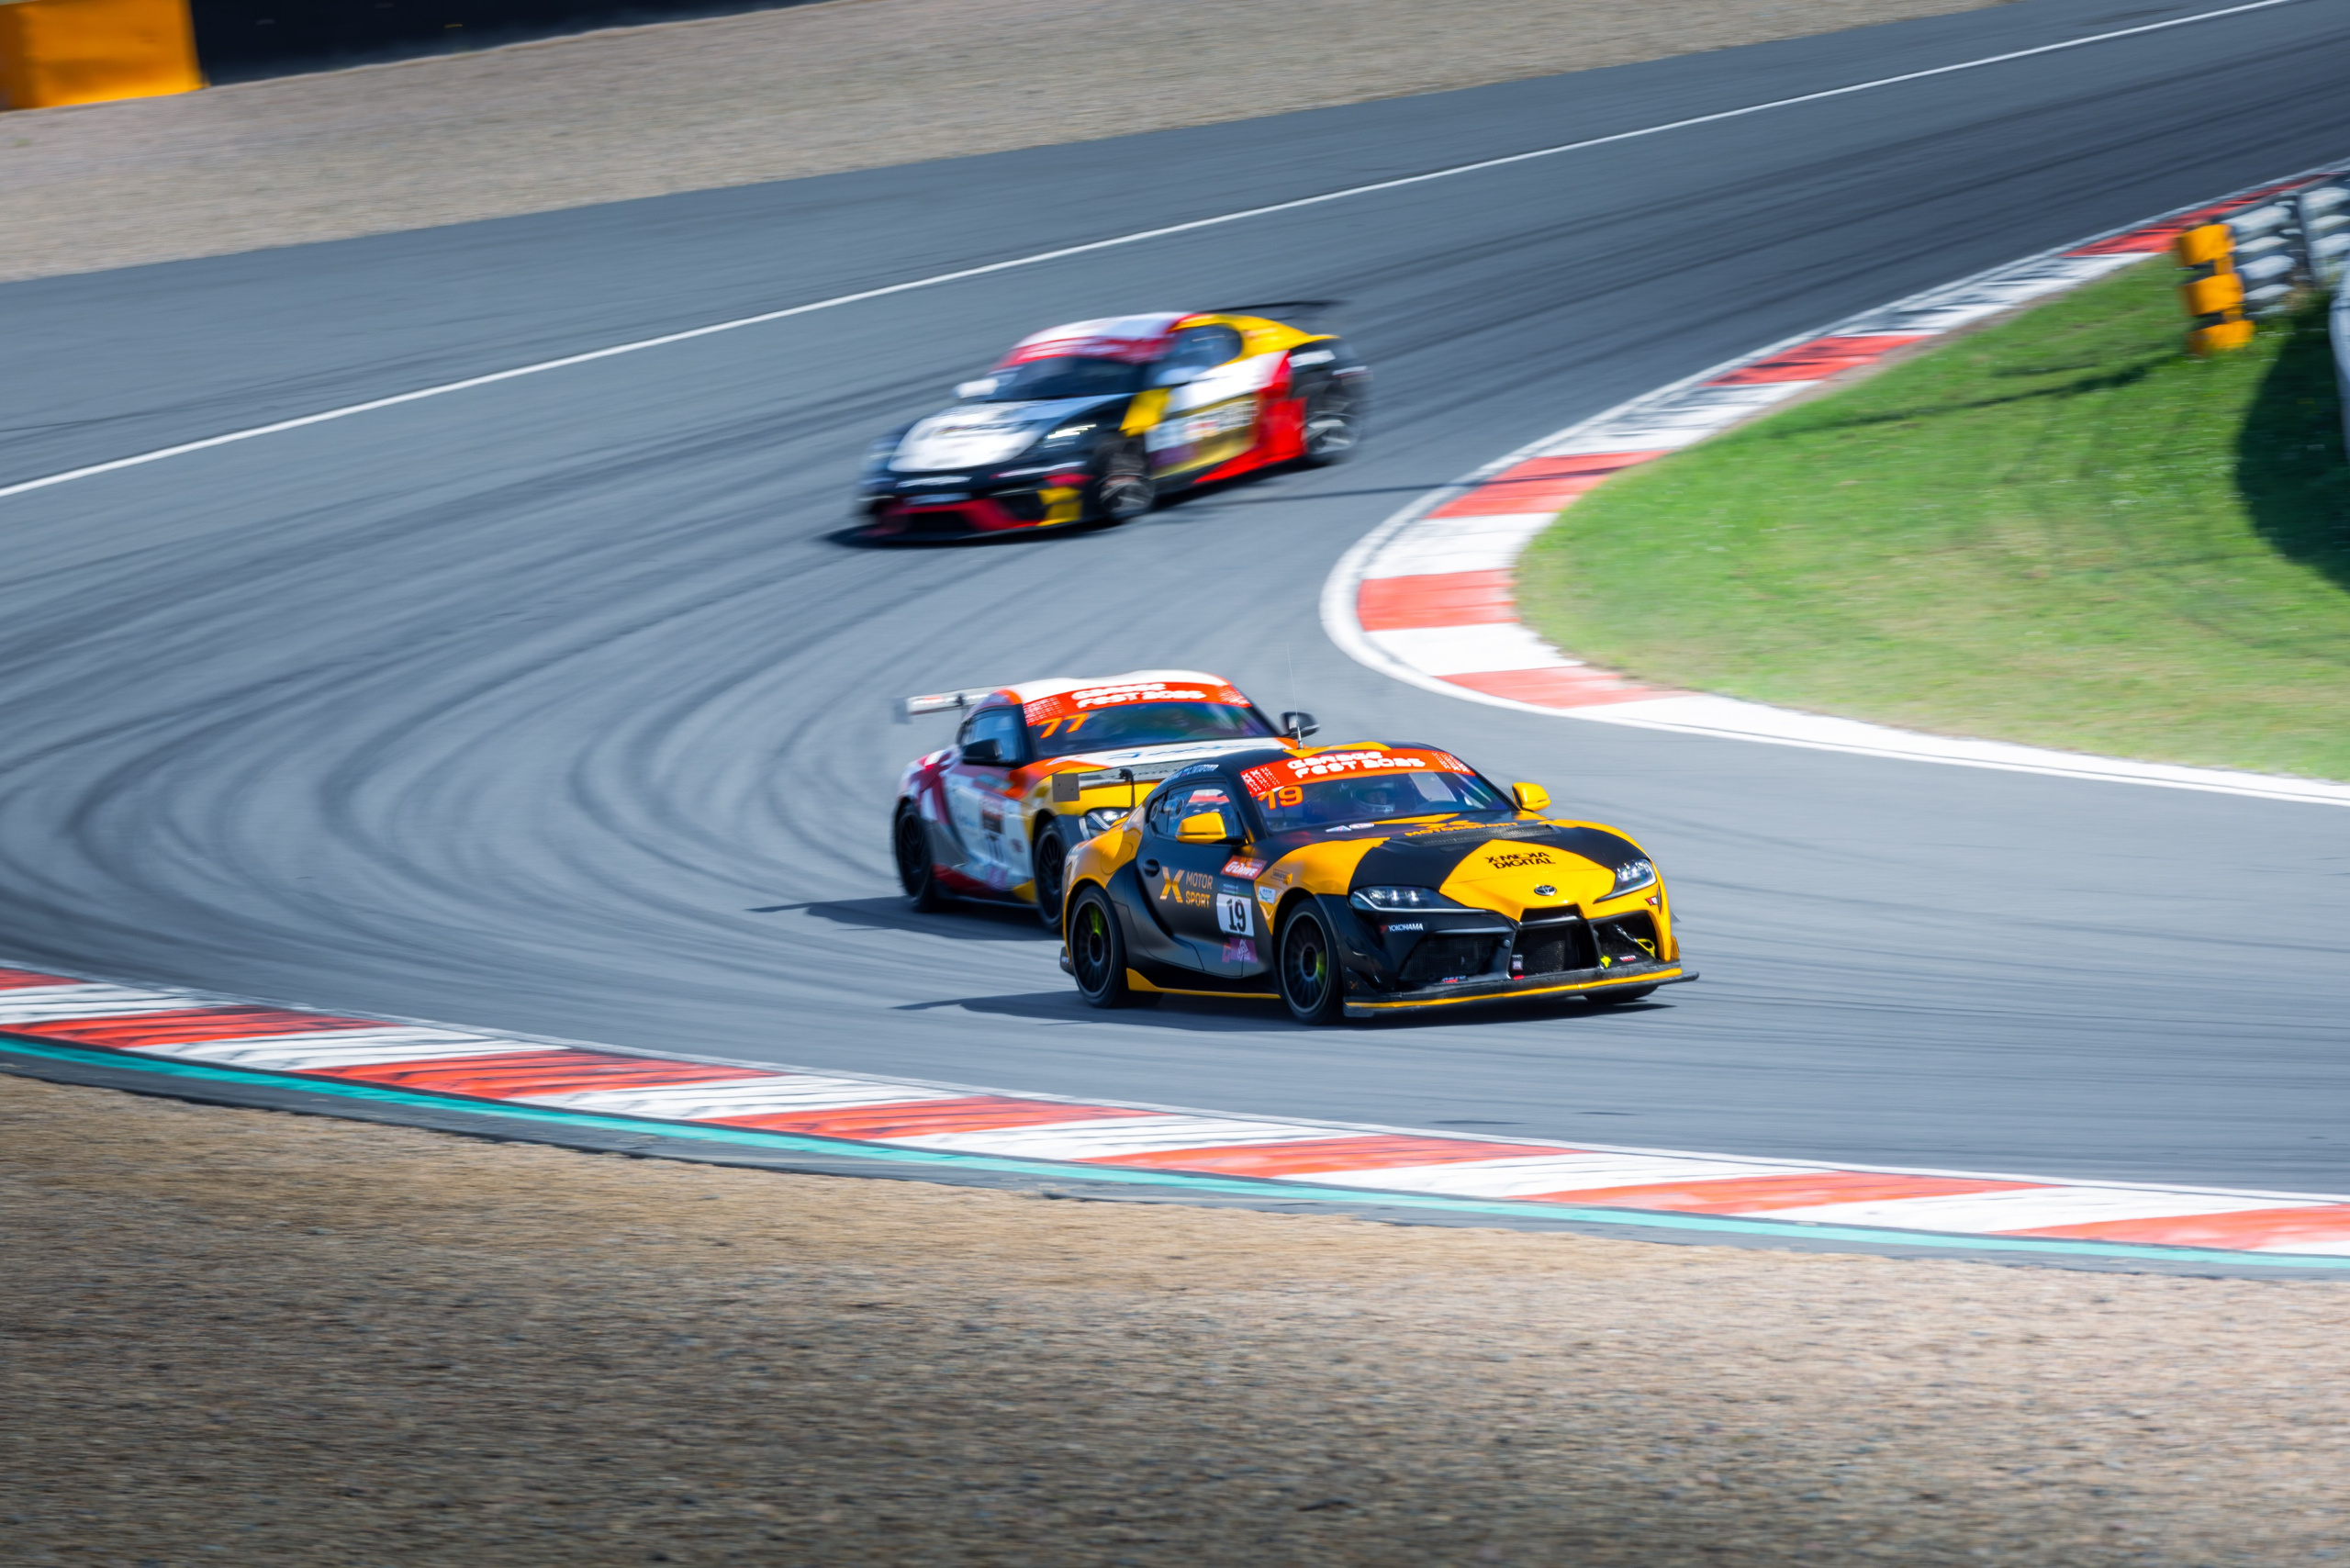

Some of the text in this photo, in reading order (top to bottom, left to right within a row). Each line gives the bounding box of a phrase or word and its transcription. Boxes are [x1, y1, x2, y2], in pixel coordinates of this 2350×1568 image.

[1036, 712, 1090, 739] 77
[1287, 751, 1382, 769] GARAGE
[1294, 758, 1426, 778] FEST 2025
[1258, 785, 1304, 810] 19
[1494, 857, 1556, 869] DIGITAL
[1159, 866, 1185, 903] X
[1185, 872, 1214, 890] MOTOR
[1185, 890, 1211, 909] SPORT
[1226, 898, 1247, 933] 19
[1388, 923, 1424, 932] YOKOHAMA
